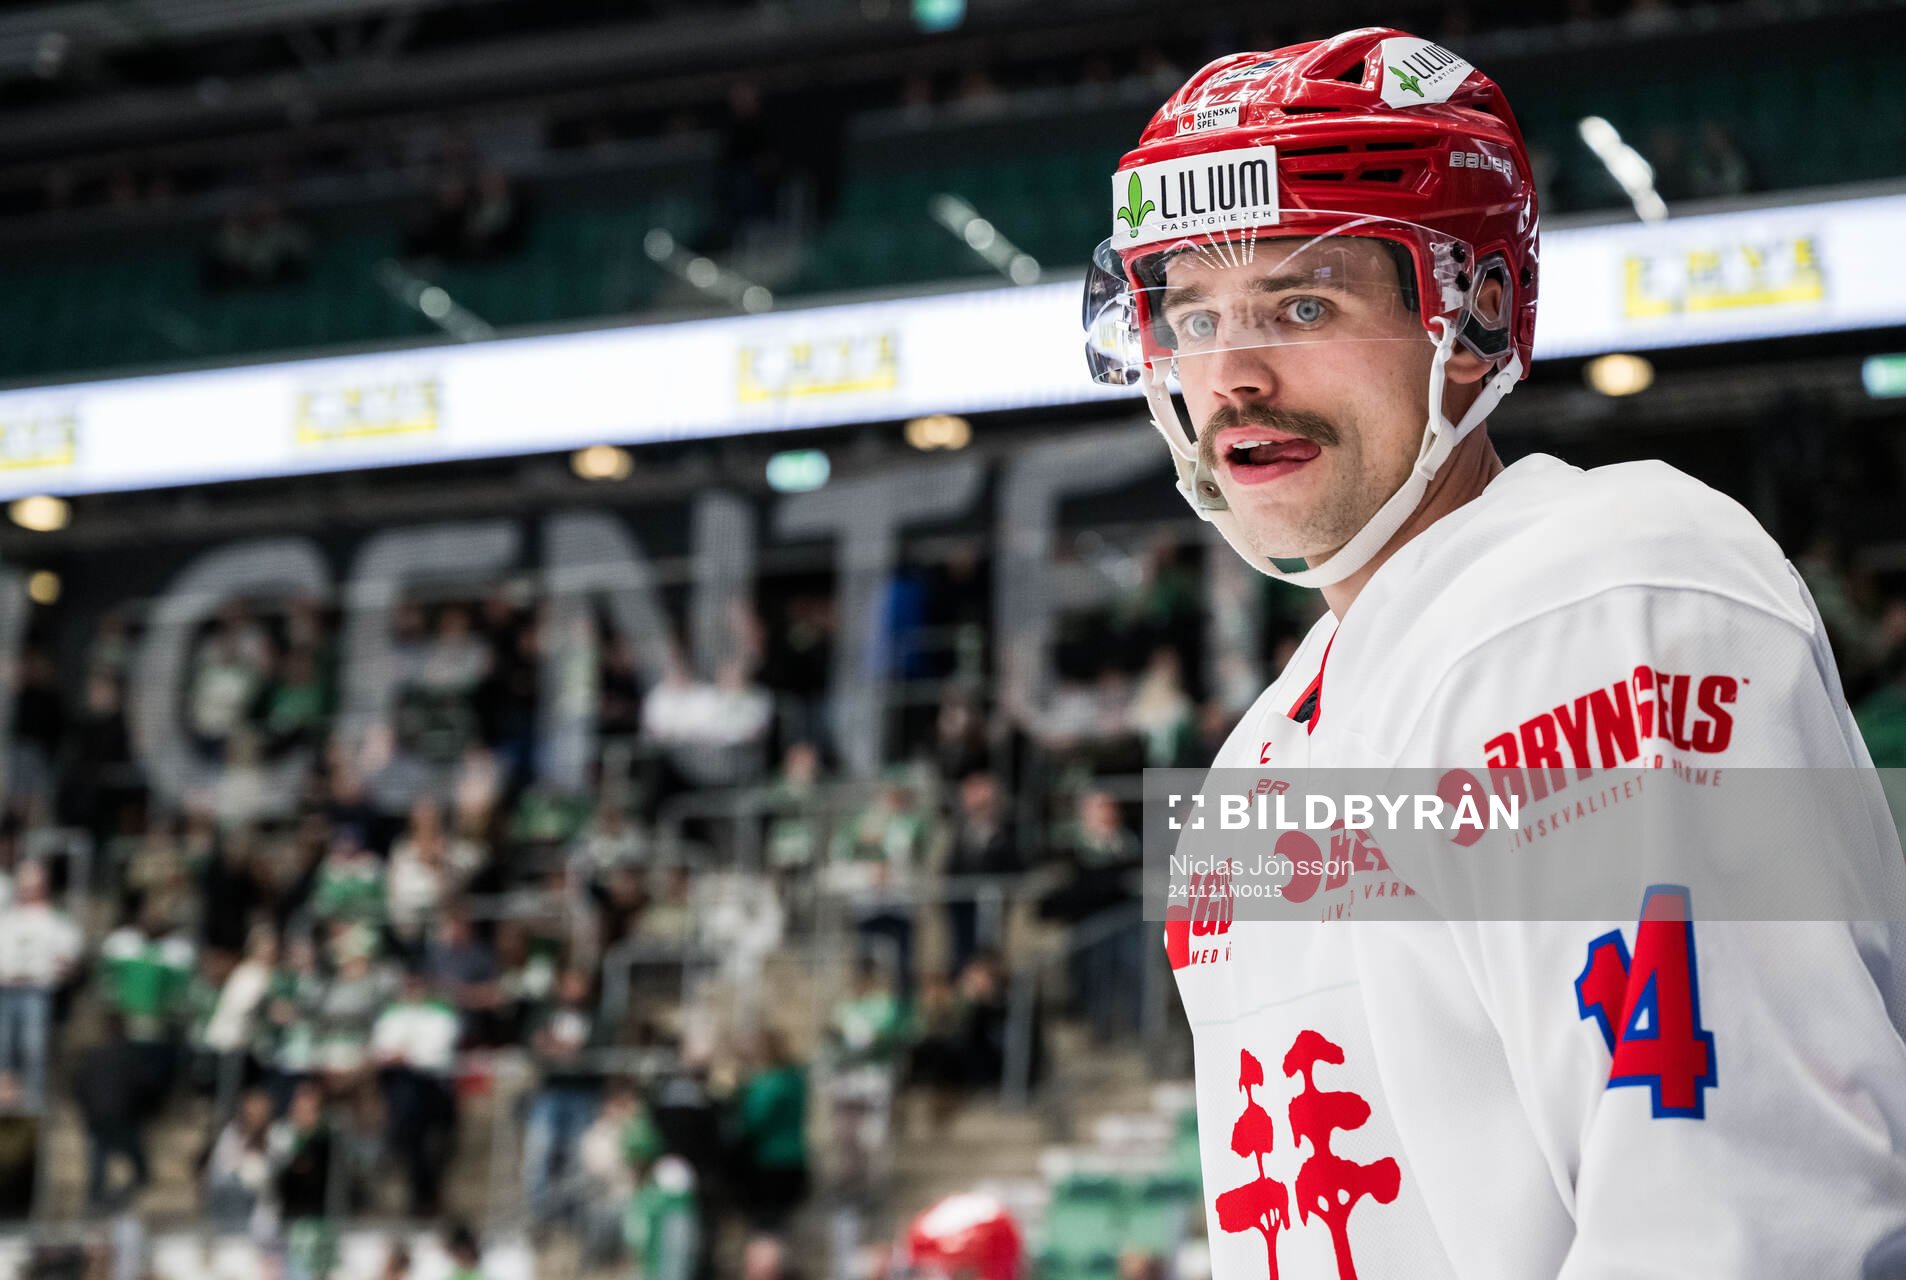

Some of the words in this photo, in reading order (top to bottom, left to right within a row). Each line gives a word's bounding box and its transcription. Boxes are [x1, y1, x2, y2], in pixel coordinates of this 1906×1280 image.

[1197, 106, 1238, 121] SVENSKA
[1197, 118, 1218, 130] SPEL
[1160, 158, 1270, 219] LILIUM
[128, 425, 1250, 808] CENTE
[1574, 884, 1718, 1120] 14
